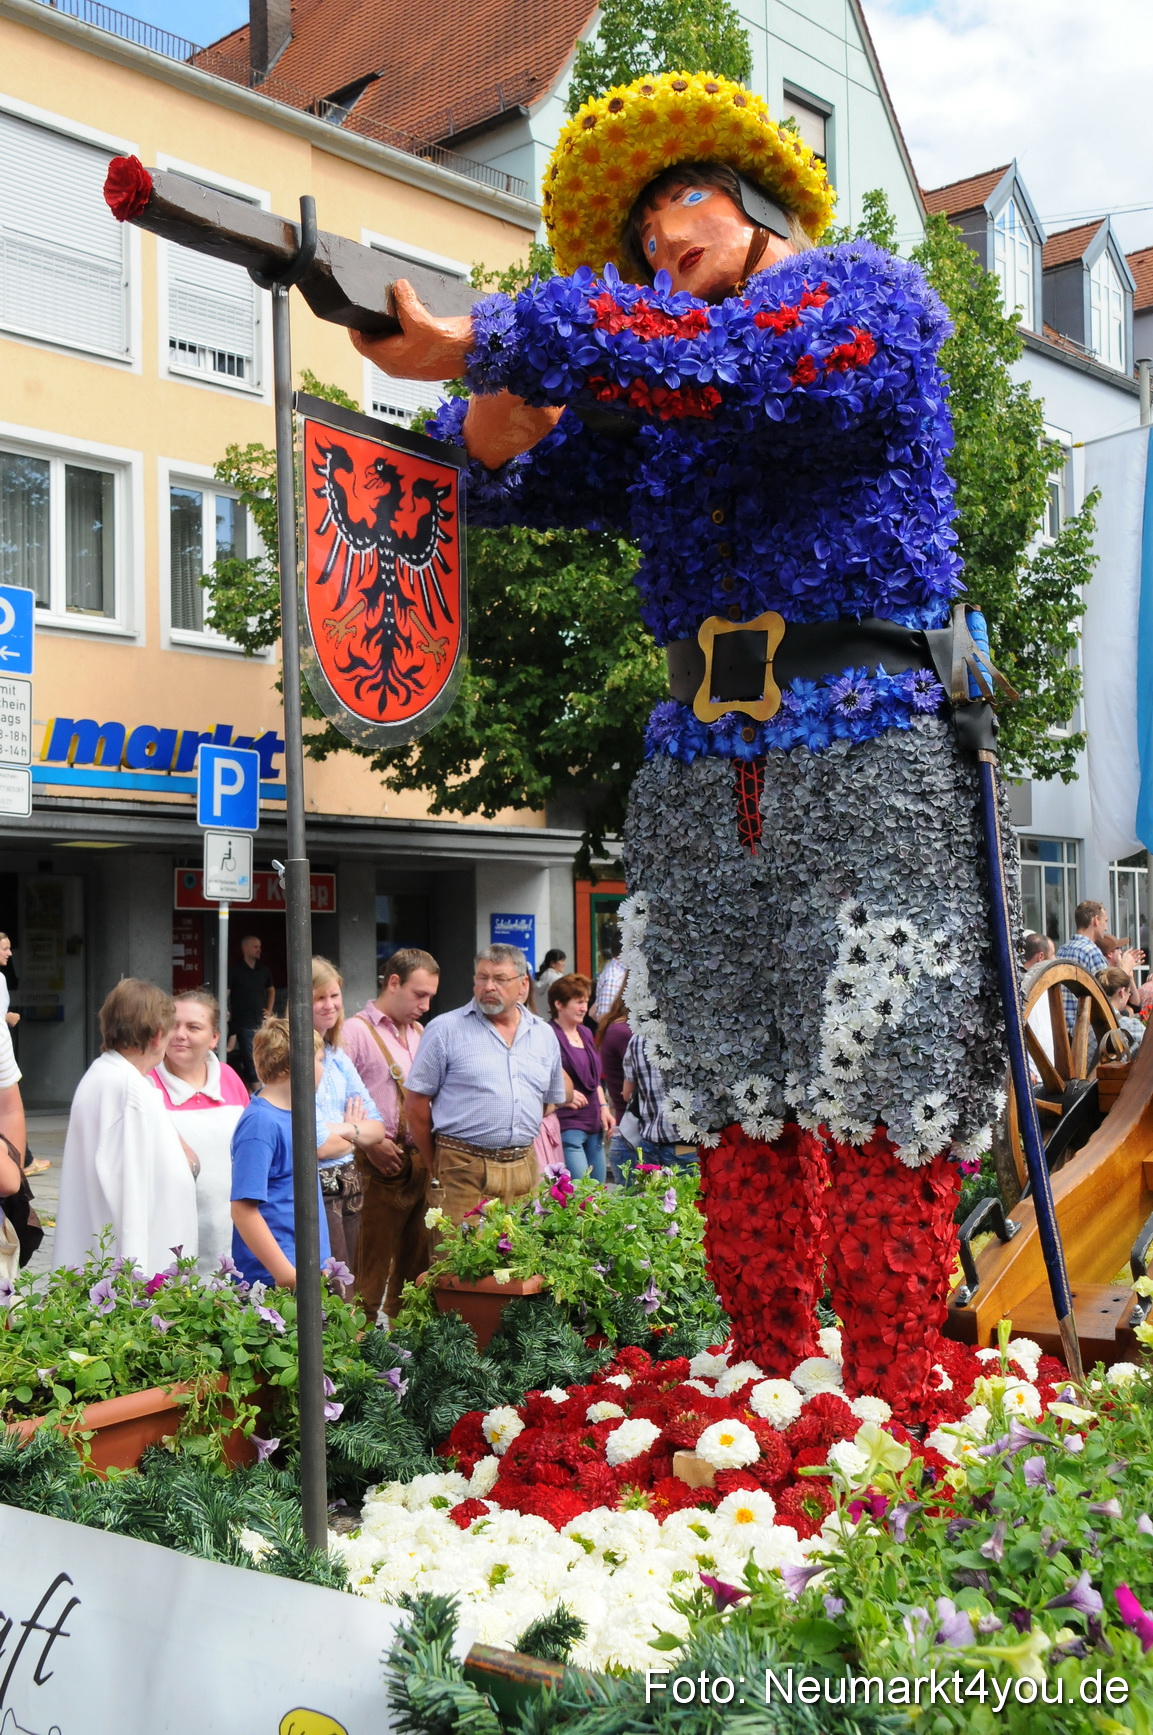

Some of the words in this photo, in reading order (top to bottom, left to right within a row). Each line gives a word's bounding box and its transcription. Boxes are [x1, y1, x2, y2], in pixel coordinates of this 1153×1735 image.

[41, 717, 285, 779] markt
[213, 757, 245, 817] P
[0, 1572, 82, 1711] ft
